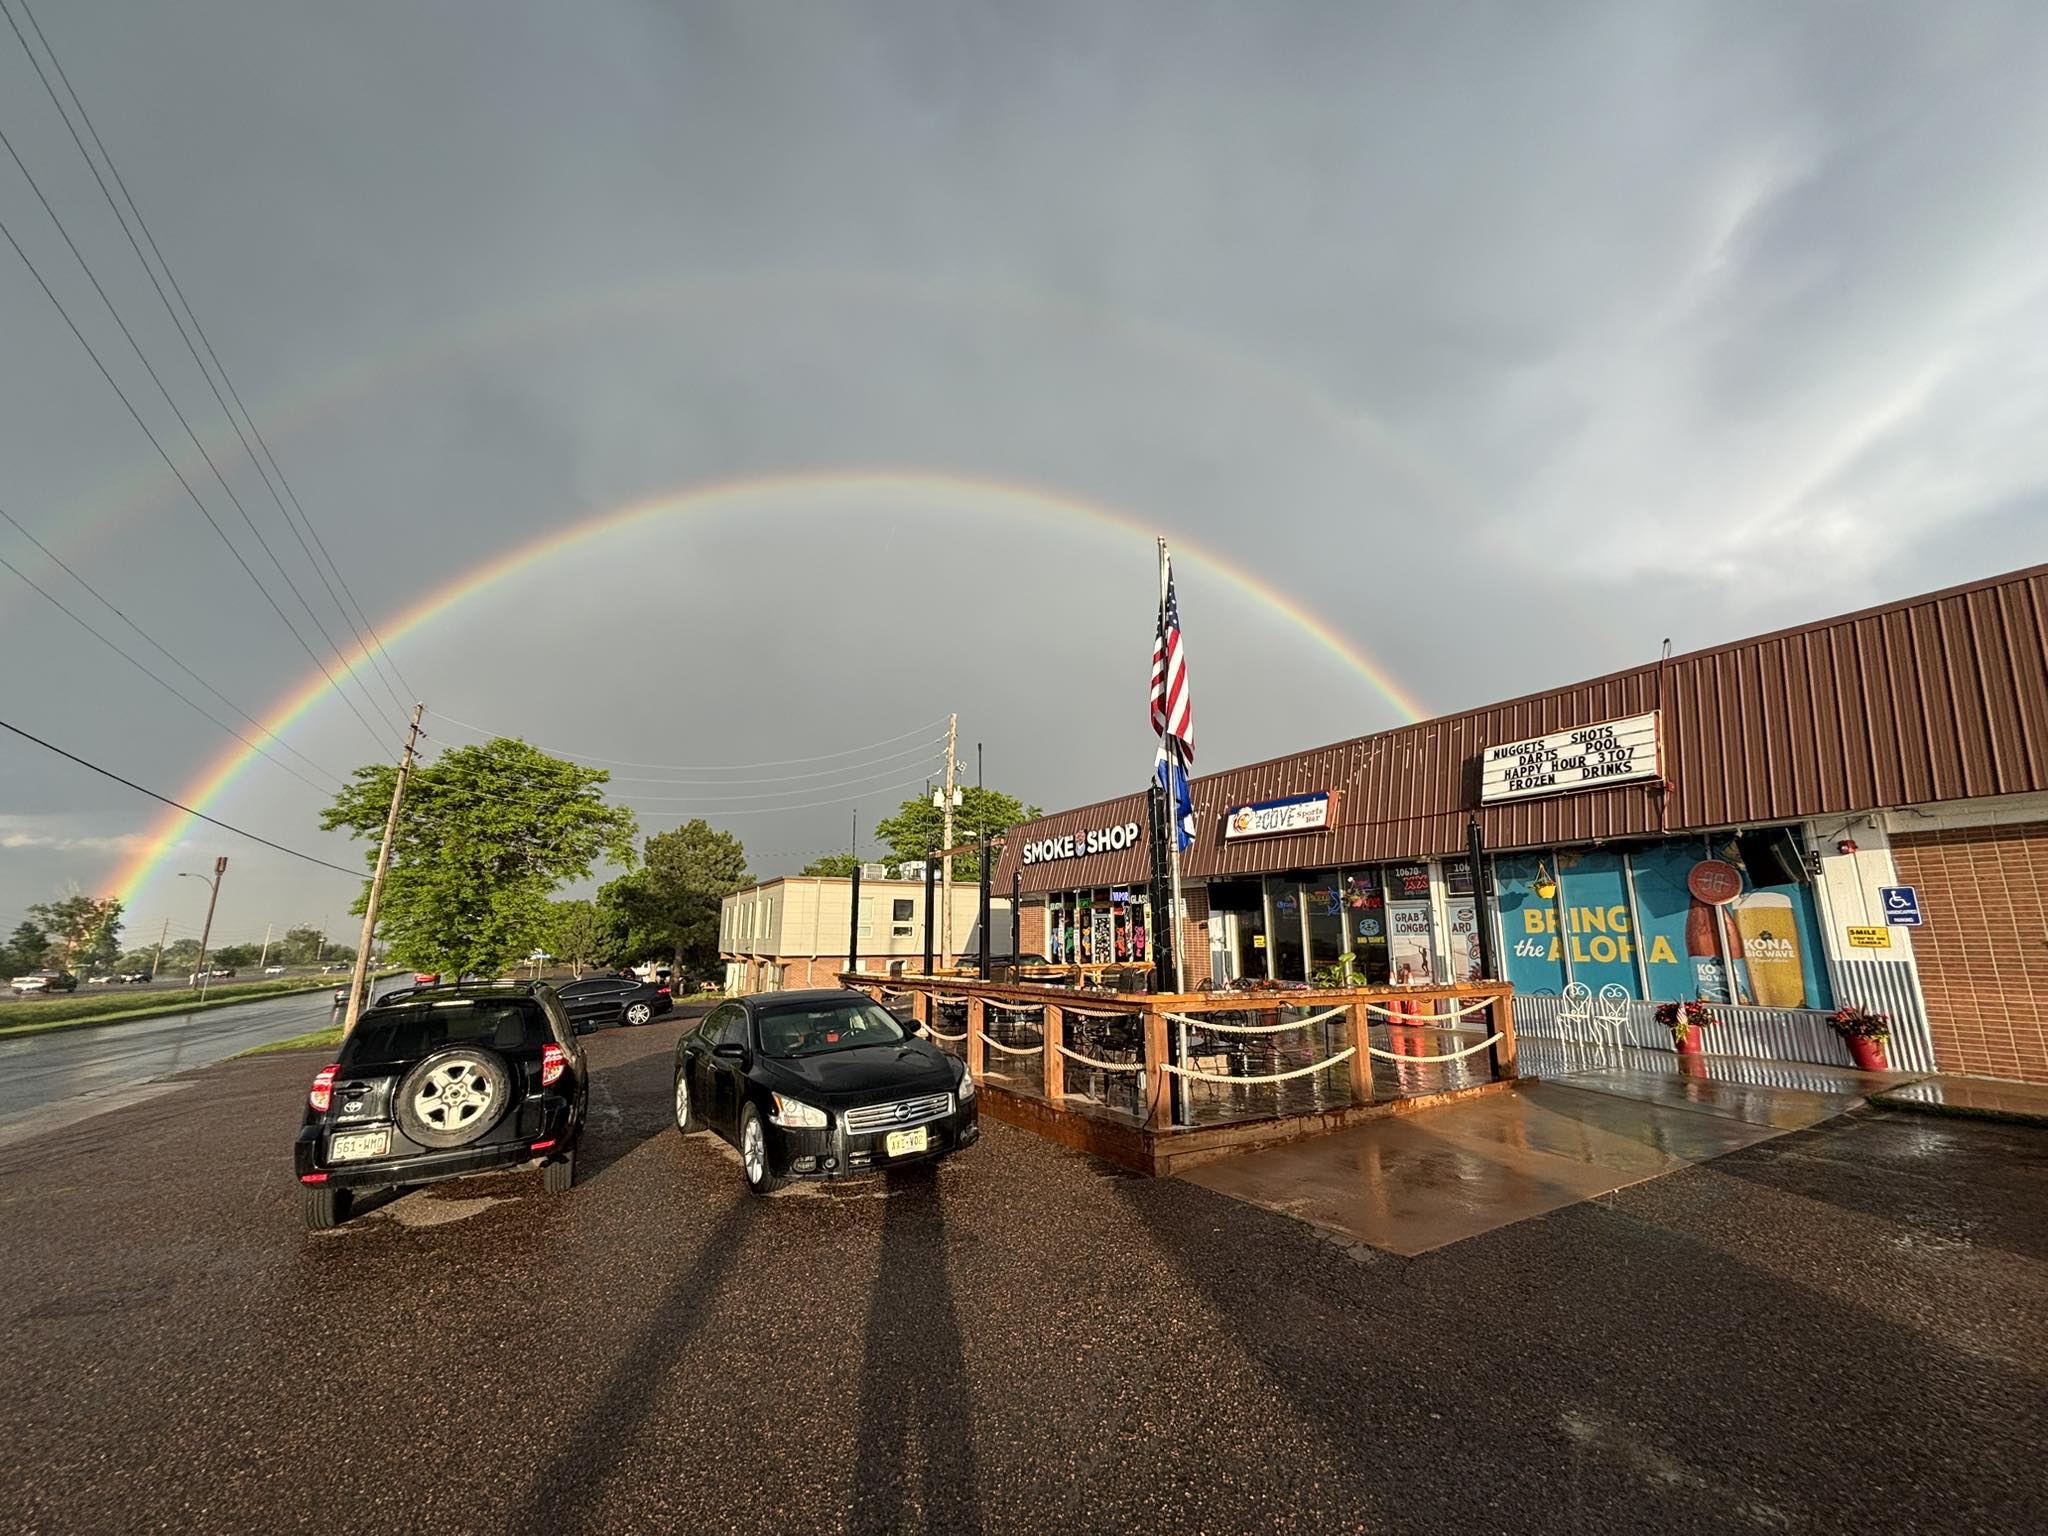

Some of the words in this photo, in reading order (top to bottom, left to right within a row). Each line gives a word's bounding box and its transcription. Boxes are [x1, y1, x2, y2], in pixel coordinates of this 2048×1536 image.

[1493, 740, 1545, 760] NUGGETS
[1571, 726, 1613, 744] SHOTS
[1519, 749, 1558, 766] DARTS
[1585, 738, 1621, 753] POOL
[1504, 763, 1543, 780] HAPPY
[1551, 756, 1586, 771] HOUR
[1509, 774, 1556, 791] FROZEN
[1582, 761, 1632, 779] DRINKS
[1261, 807, 1297, 830] COVE
[1023, 834, 1075, 865] SMOKE
[1086, 822, 1139, 853] SHOP
[1394, 912, 1420, 922] GRAB
[1523, 905, 1632, 934] BRING
[1514, 938, 1545, 957] the
[1546, 935, 1679, 964] ALOHA
[1744, 938, 1793, 950] KONA
[1745, 950, 1763, 958] BIG
[1764, 950, 1795, 958] WAVE
